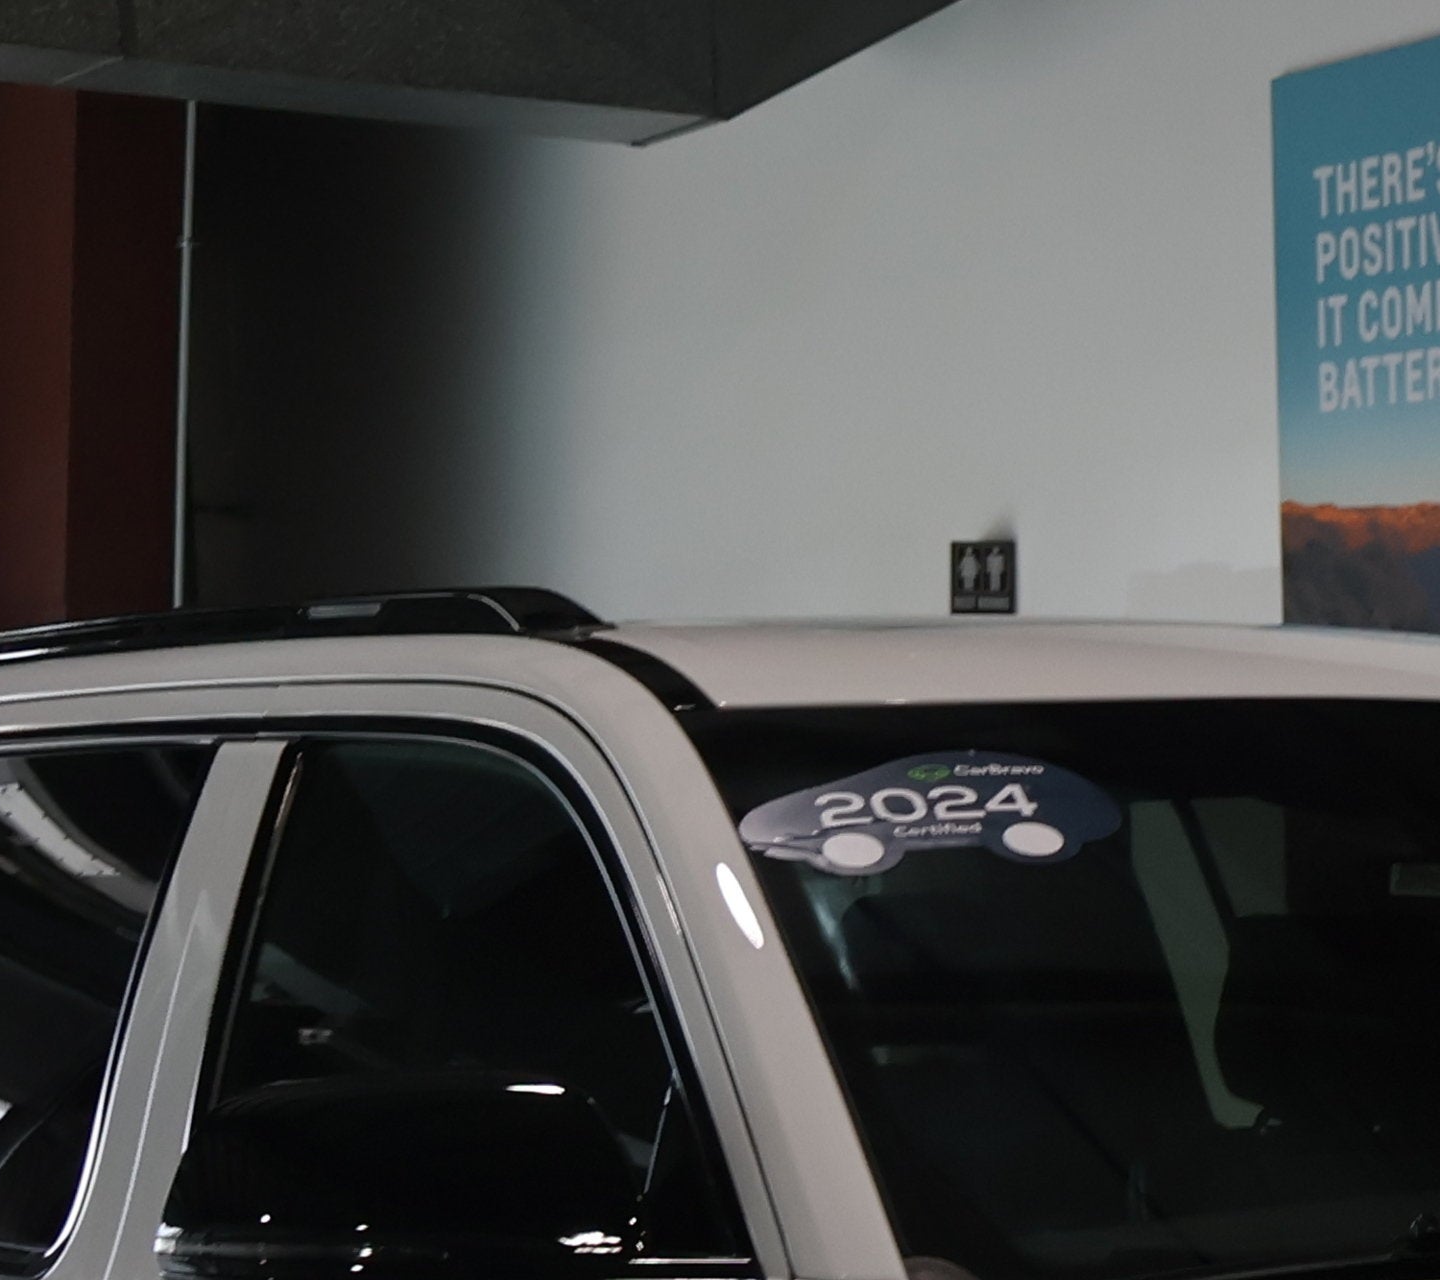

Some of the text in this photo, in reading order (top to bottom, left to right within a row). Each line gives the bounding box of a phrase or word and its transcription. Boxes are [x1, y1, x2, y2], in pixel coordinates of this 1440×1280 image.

[1317, 294, 1348, 349] IT
[815, 783, 1038, 828] 2024
[892, 821, 983, 838] Certified
